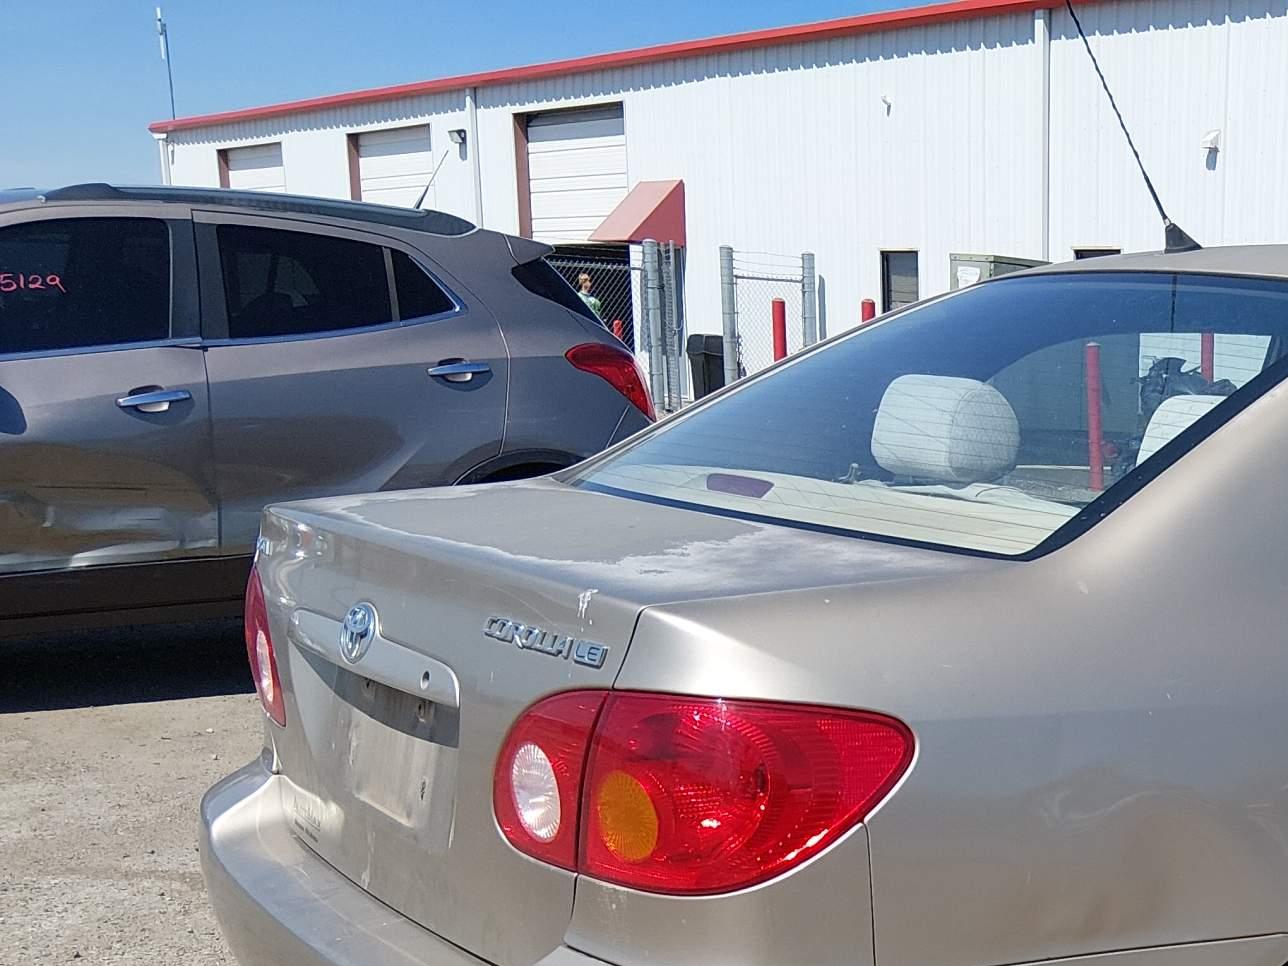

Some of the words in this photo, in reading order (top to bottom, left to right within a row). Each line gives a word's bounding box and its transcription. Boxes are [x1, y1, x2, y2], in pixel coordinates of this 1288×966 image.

[0, 273, 67, 294] 5129
[483, 616, 574, 660] COROLLA
[574, 640, 605, 665] LE
